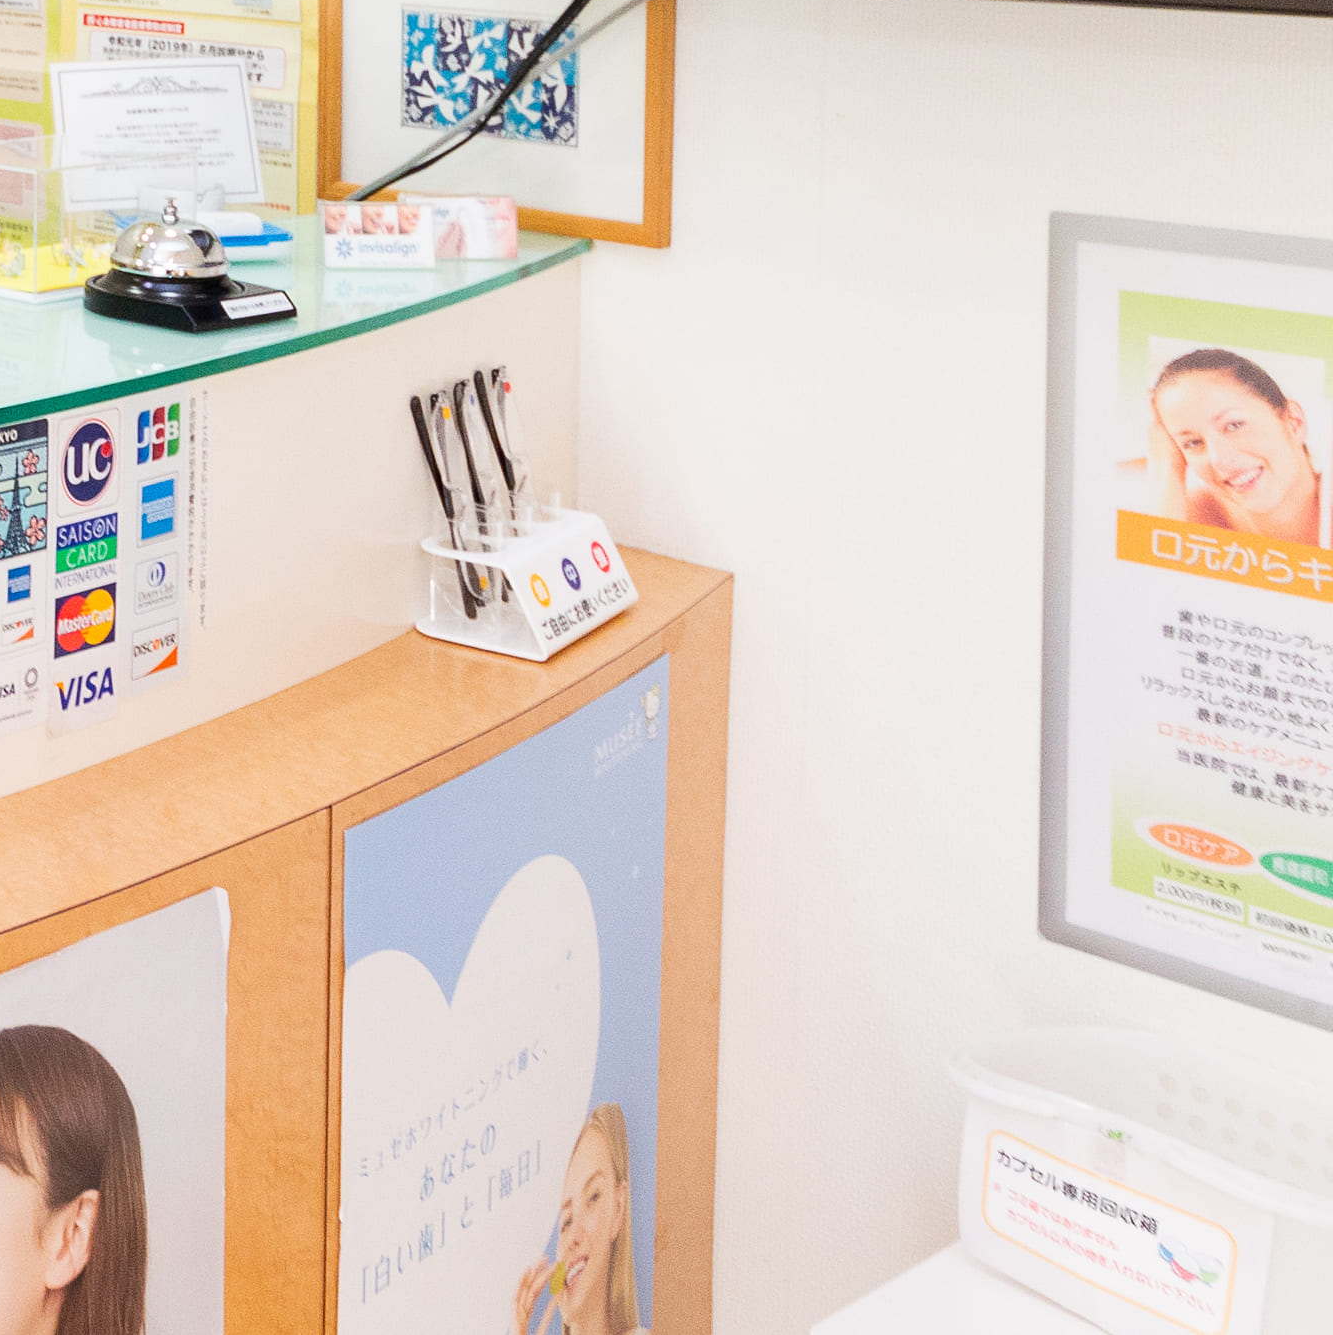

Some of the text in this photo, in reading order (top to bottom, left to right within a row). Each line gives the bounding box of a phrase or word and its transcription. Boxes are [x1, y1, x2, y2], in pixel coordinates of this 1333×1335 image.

[357, 240, 418, 257] invisalign
[136, 402, 181, 466] JCB
[57, 516, 117, 549] SAISON
[65, 540, 109, 570] CARD
[1151, 528, 1333, 592] 口元からキ
[54, 563, 118, 590] INTERNATIONAL
[57, 605, 114, 637] MasterCard
[542, 577, 631, 641] ご自由にお使いください
[133, 632, 177, 658] DISCOVER
[54, 666, 115, 712] VISA
[1162, 827, 1241, 862] 口元ケア
[417, 1122, 498, 1204] あなたの
[996, 1148, 1159, 1237] カプセル専用回収箱
[361, 1140, 545, 1307] 「白い歯」と「毎日」
